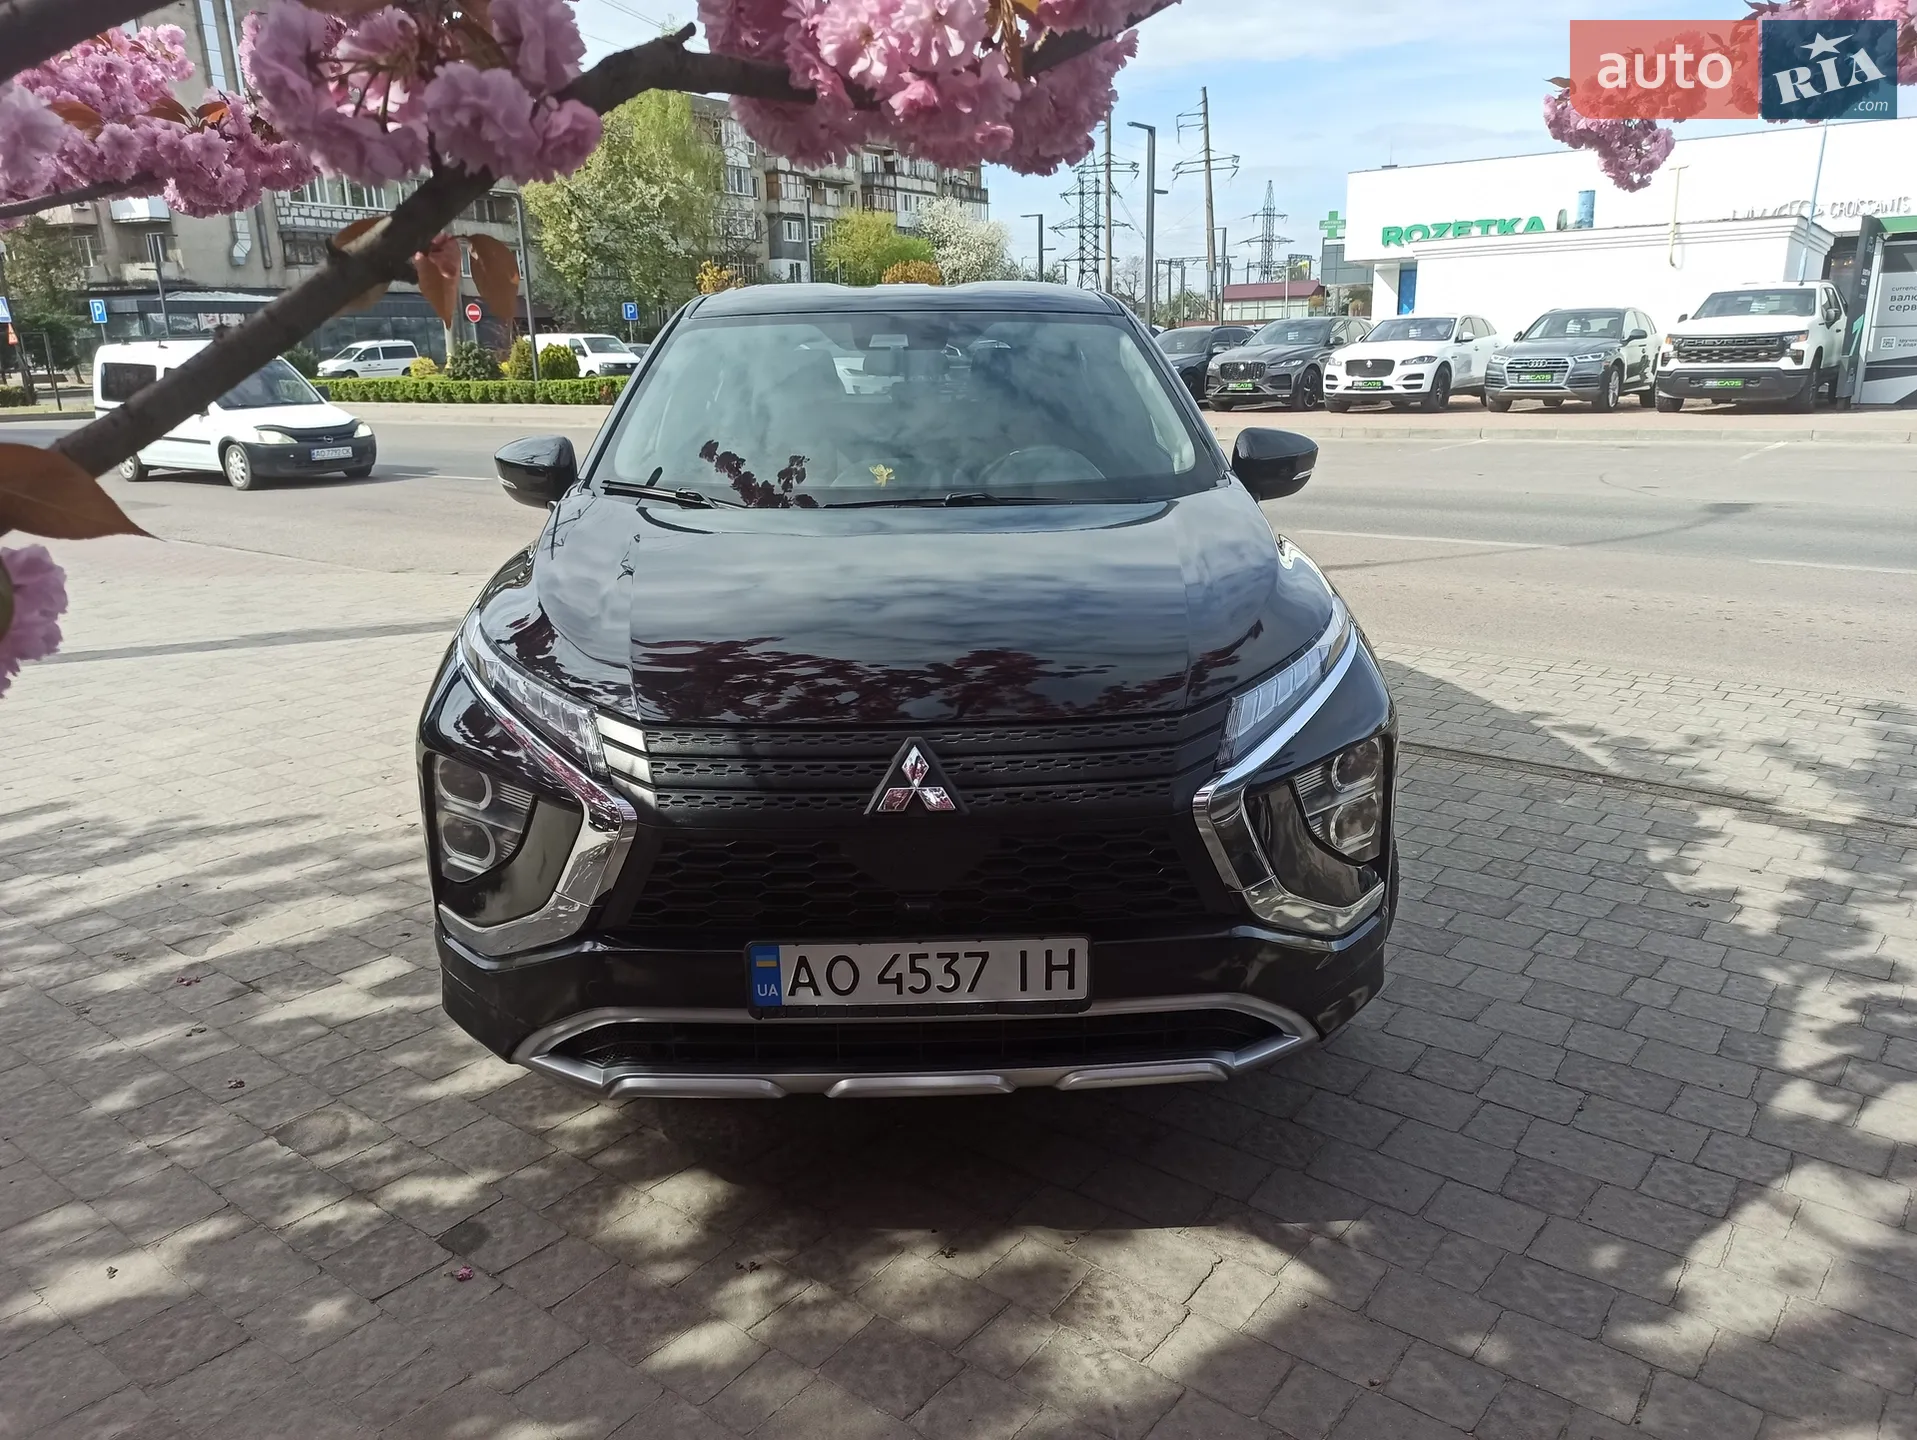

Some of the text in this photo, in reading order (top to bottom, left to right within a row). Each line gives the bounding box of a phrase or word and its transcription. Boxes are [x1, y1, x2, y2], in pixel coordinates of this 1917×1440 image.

[1382, 216, 1546, 247] ROZETKA
[787, 948, 1076, 997] AO 4537 IH
[757, 983, 779, 997] UA
